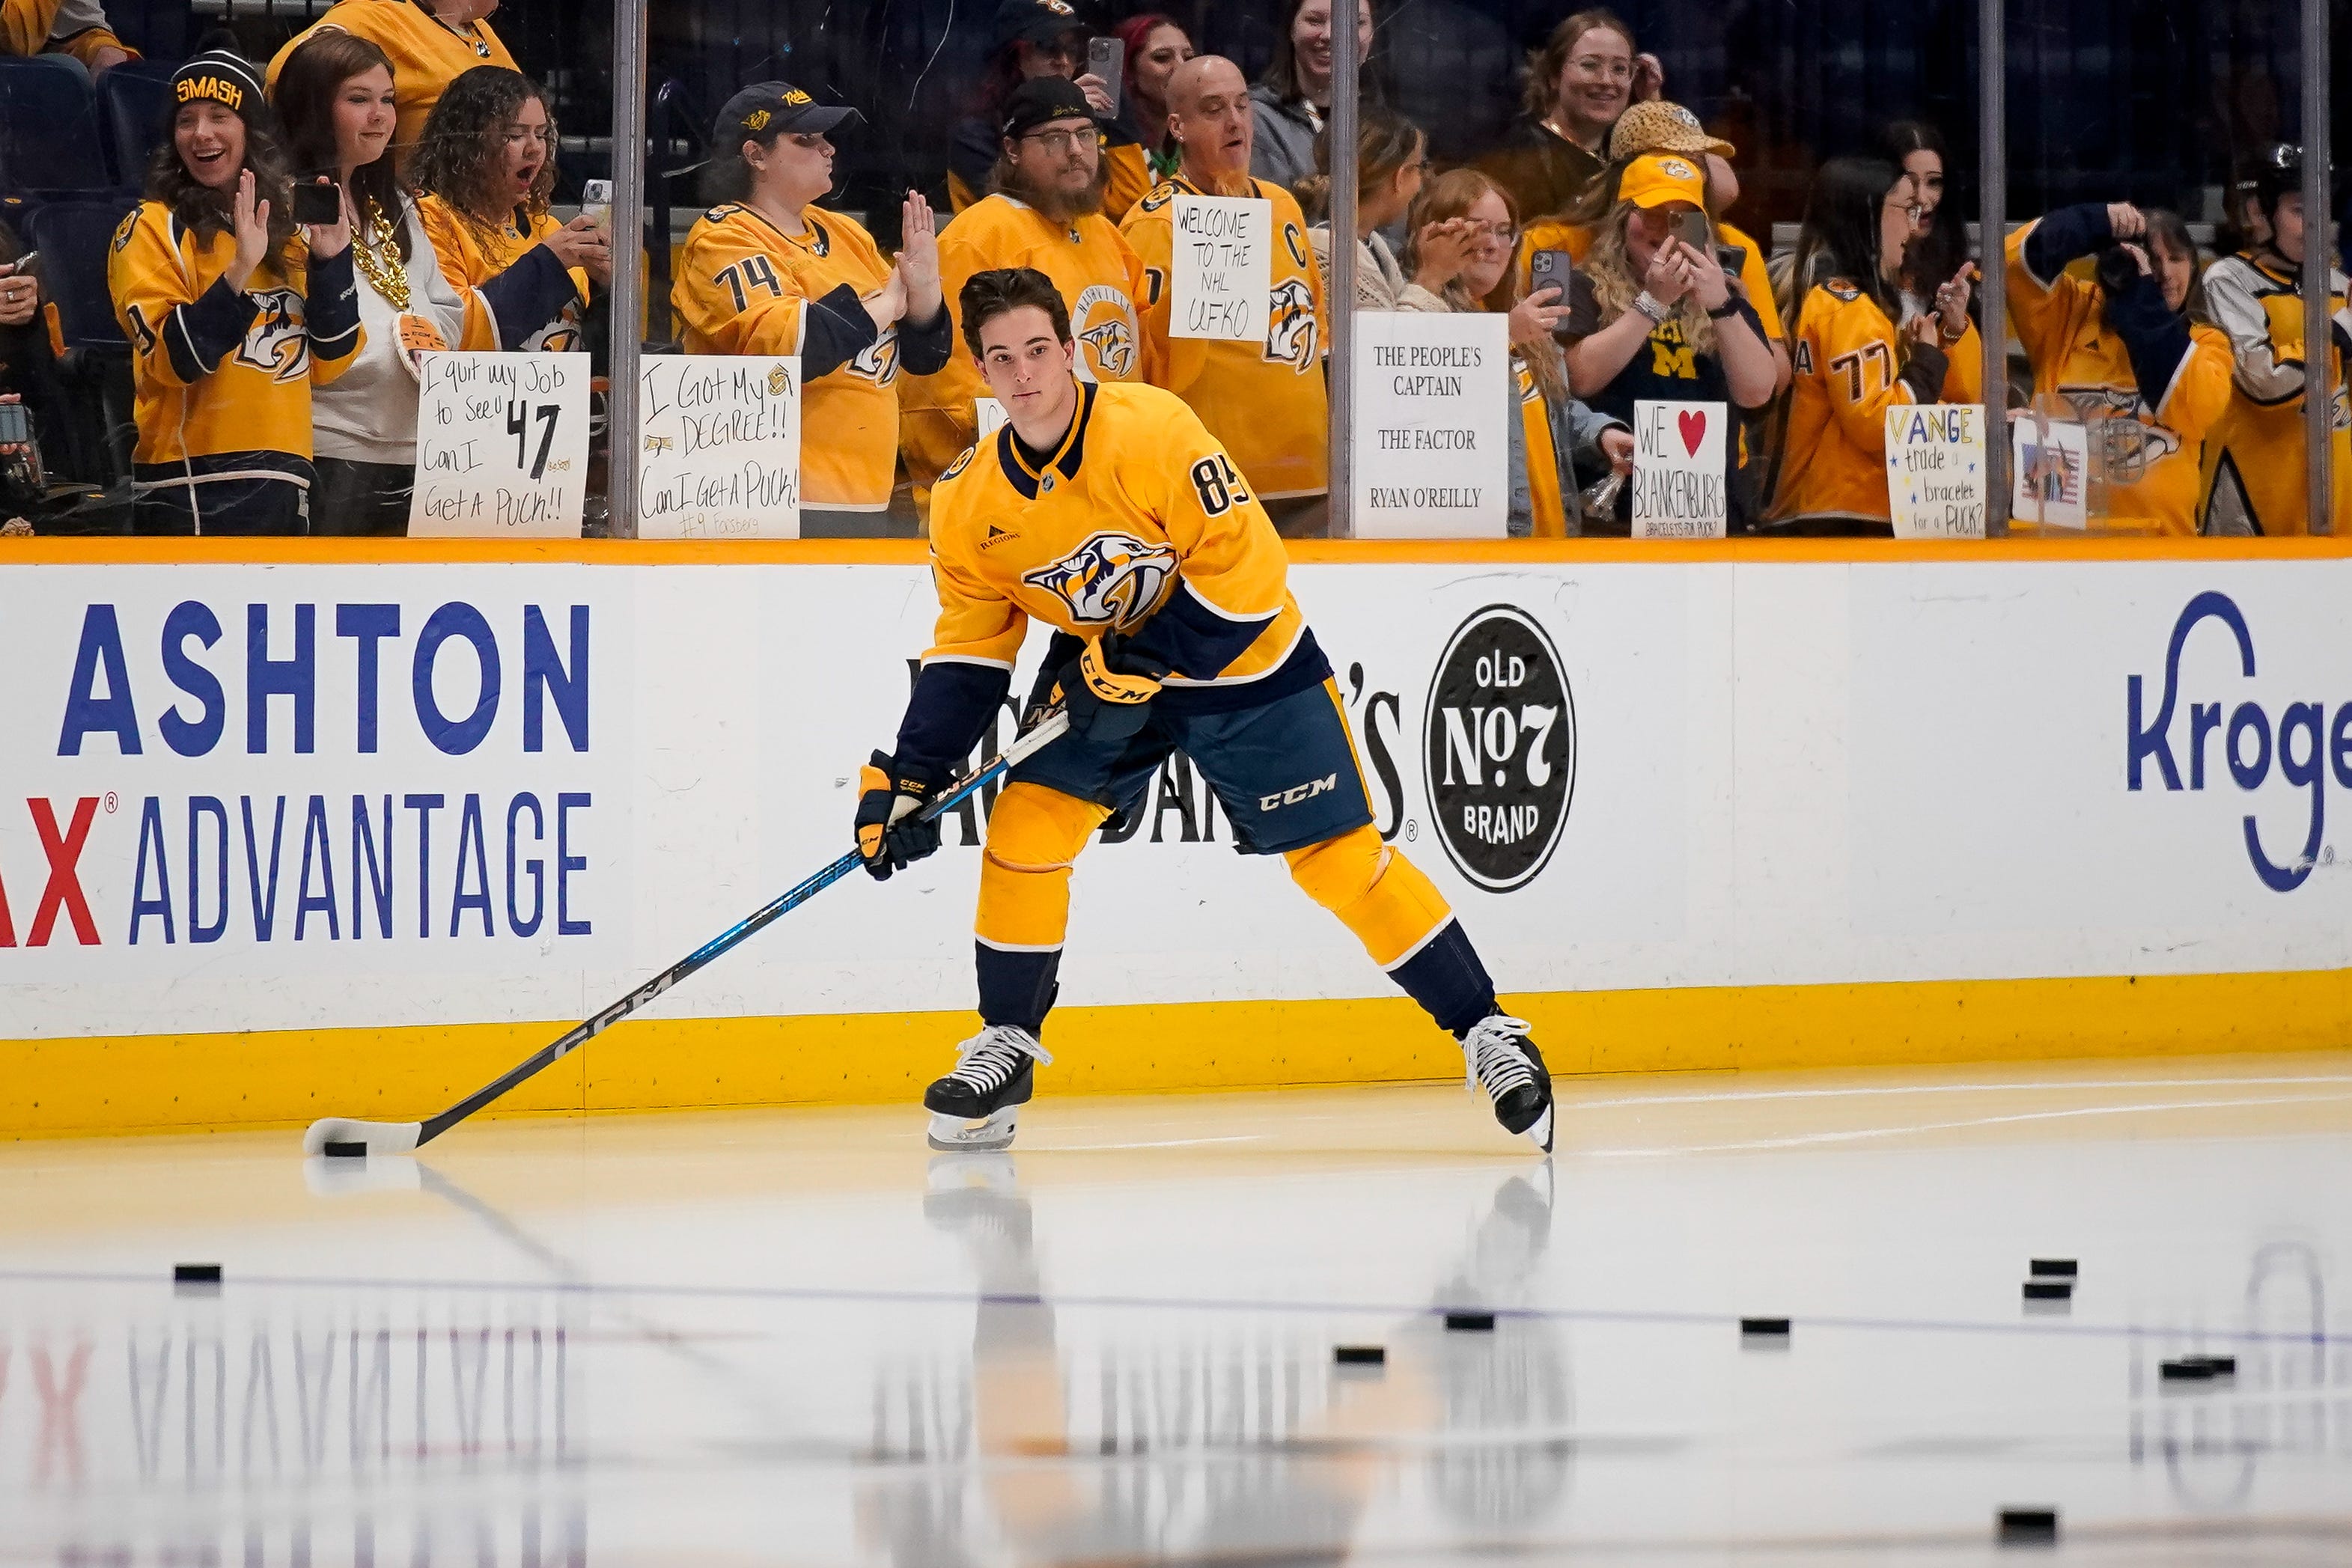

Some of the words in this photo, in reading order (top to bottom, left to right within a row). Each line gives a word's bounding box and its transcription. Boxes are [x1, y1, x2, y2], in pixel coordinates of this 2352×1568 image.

[177, 76, 243, 110] SMASH
[1176, 204, 1250, 238] WELCOME
[1192, 242, 1214, 267] TO
[1219, 244, 1251, 268] THE
[1284, 222, 1307, 269] C
[713, 254, 782, 314] 74
[1201, 271, 1230, 293] NHL
[1189, 297, 1249, 338] UFKO
[424, 356, 440, 396] I
[445, 358, 481, 393] quit
[1374, 347, 1406, 366] THE
[1410, 347, 1481, 367] PEOPLE'S
[1651, 341, 1697, 379] M
[1793, 338, 1814, 375] A
[1829, 338, 1892, 405] 77
[642, 362, 670, 424] I
[1393, 376, 1462, 396] CAPTAIN
[435, 399, 452, 425] to
[682, 401, 787, 458] DEGREE!!
[1635, 405, 1668, 458] WE
[1888, 408, 1973, 445] VANGE
[424, 439, 459, 472] Can
[460, 439, 484, 474] I
[507, 400, 562, 483] 47
[1378, 430, 1410, 449] THE
[1415, 430, 1477, 450] FACTOR
[1904, 446, 1945, 472] trade
[470, 492, 484, 518] A
[640, 466, 674, 519] Can
[1370, 487, 1410, 507] RYAN
[1413, 487, 1482, 508] O'REILLY
[1633, 466, 1725, 519] BLANKENBURG
[1923, 478, 1975, 503] bracelet
[1946, 503, 1984, 535] PUCK?
[56, 600, 591, 757] ASHTON
[1082, 653, 1150, 701] CCM
[1475, 648, 1526, 688] OLD
[900, 778, 926, 790] CCM
[1259, 772, 1337, 812] CCM
[1463, 805, 1540, 846] BRAND
[129, 791, 592, 946] ADVANTAGE
[555, 971, 674, 1061] CCM
